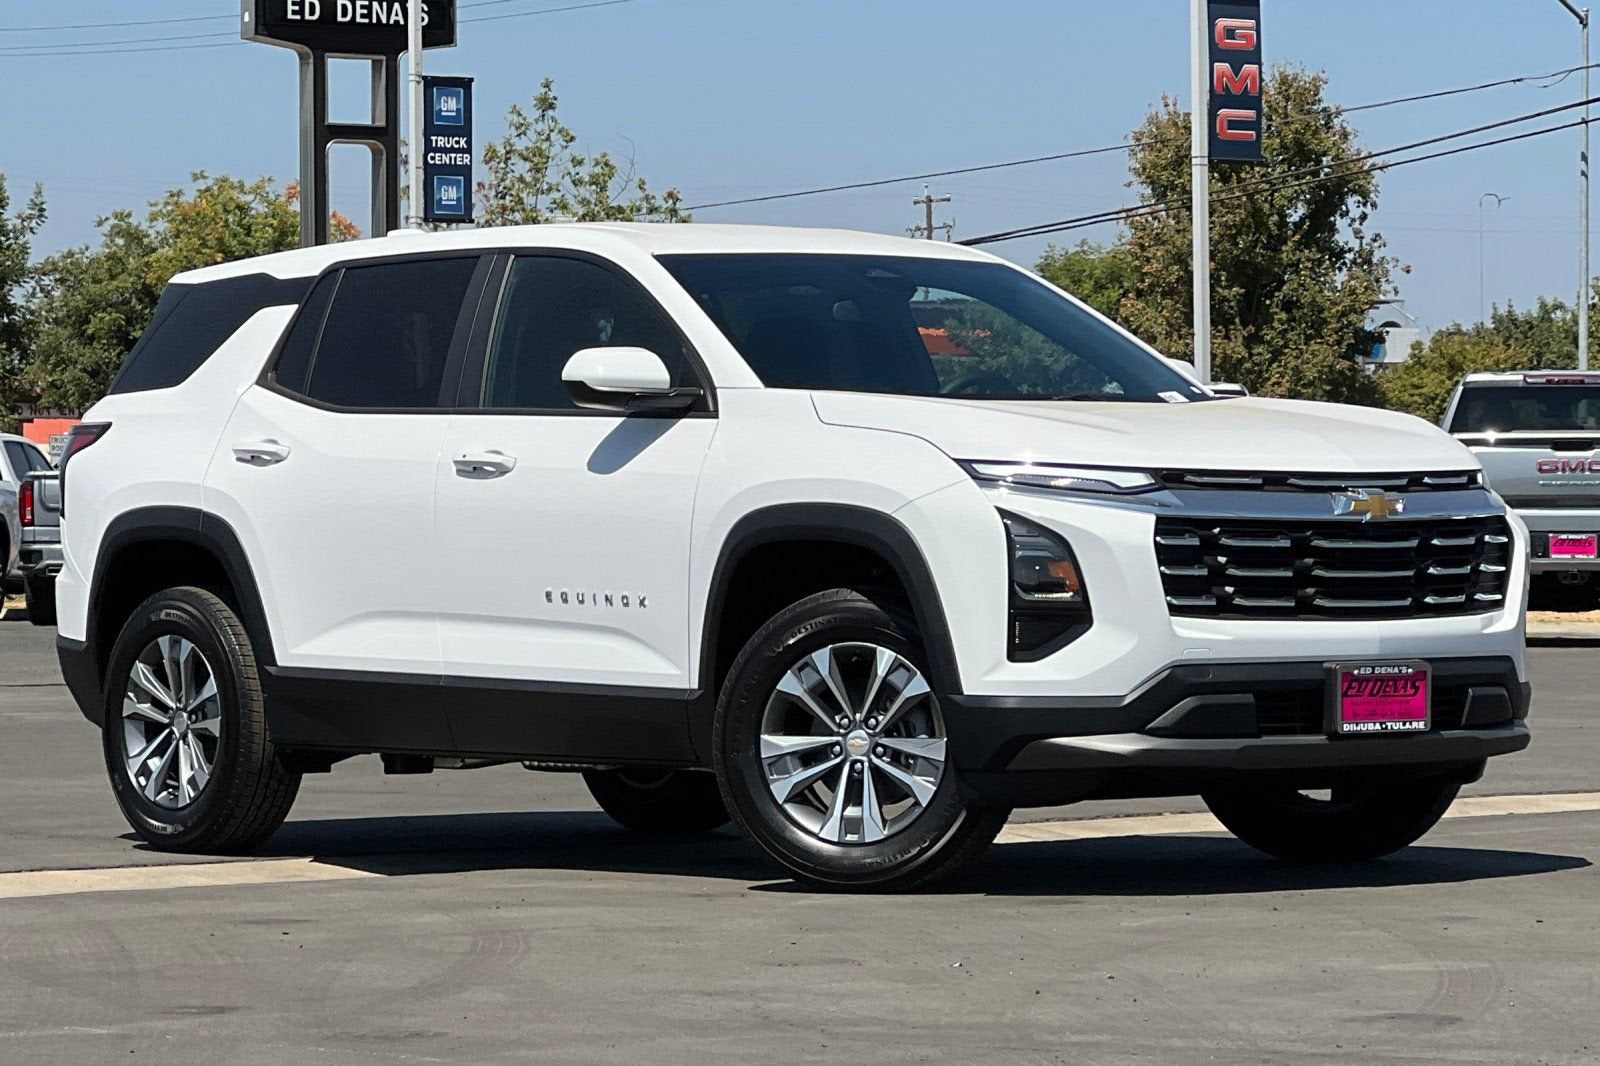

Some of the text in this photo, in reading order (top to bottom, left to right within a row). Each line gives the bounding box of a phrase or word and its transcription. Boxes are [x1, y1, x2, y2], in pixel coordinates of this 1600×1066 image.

[287, 0, 321, 20] ED
[1213, 17, 1260, 141] GMC
[441, 96, 457, 111] GM
[430, 136, 468, 148] TRUCK
[427, 152, 471, 165] CENTER
[441, 185, 457, 200] GM
[545, 590, 647, 608] EQUINOX
[1386, 721, 1426, 730] TULARE
